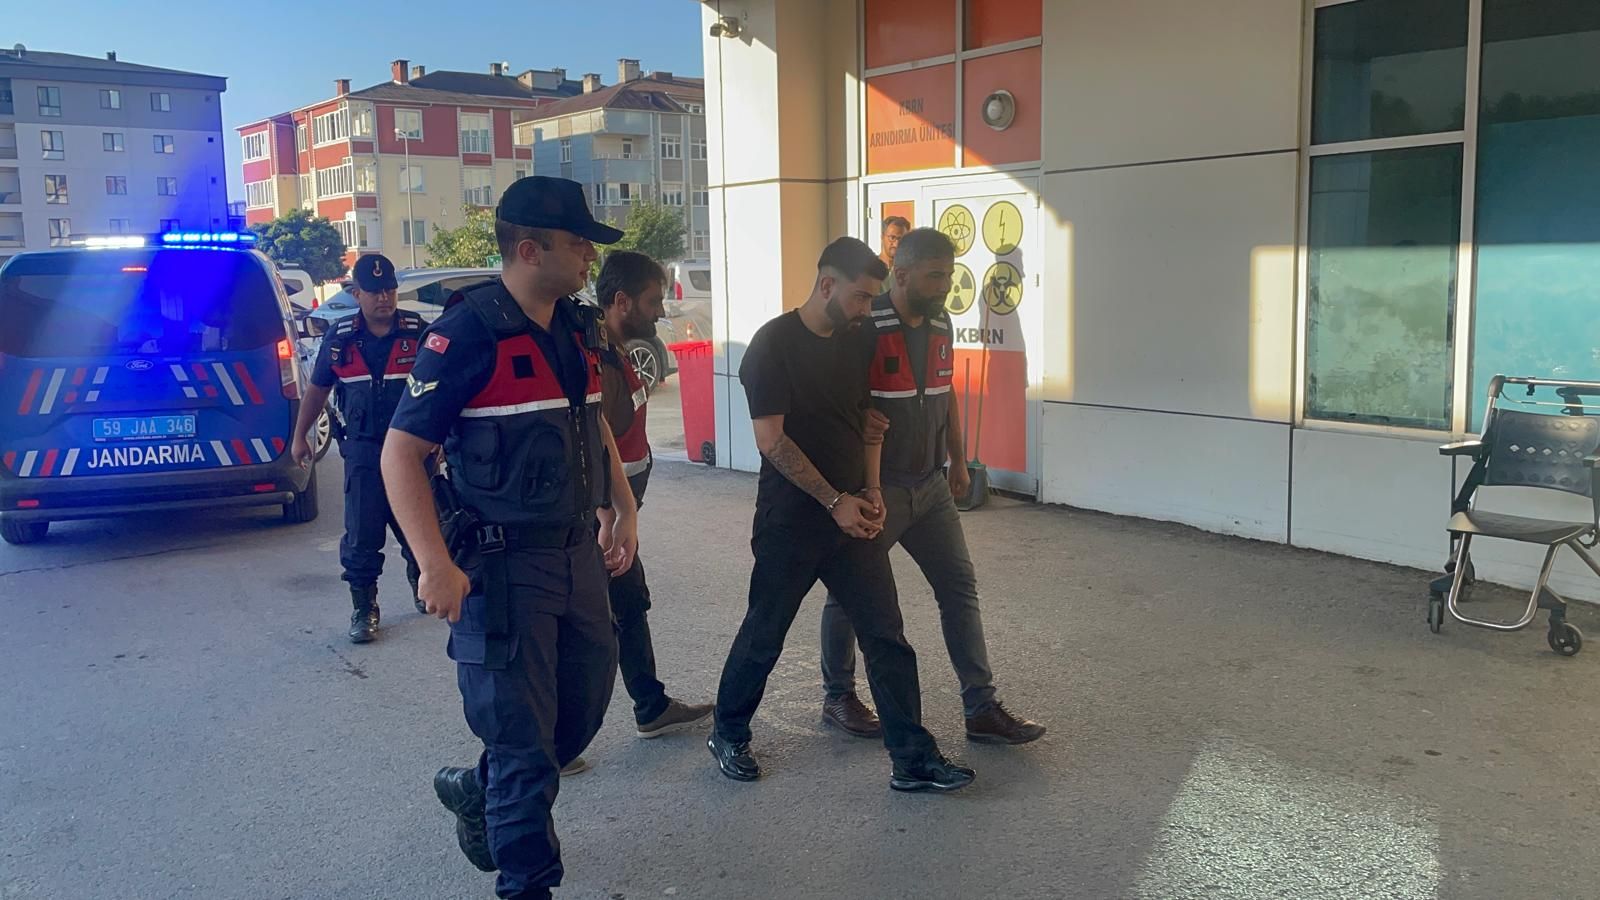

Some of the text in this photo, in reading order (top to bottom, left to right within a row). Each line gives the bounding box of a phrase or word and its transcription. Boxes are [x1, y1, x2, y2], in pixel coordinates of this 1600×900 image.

[899, 97, 924, 116] KBRN
[869, 127, 918, 148] ARINDIRMA
[956, 328, 1004, 344] KBRN
[103, 418, 193, 436] 59 JAA 346
[87, 443, 205, 468] JANDARMA
